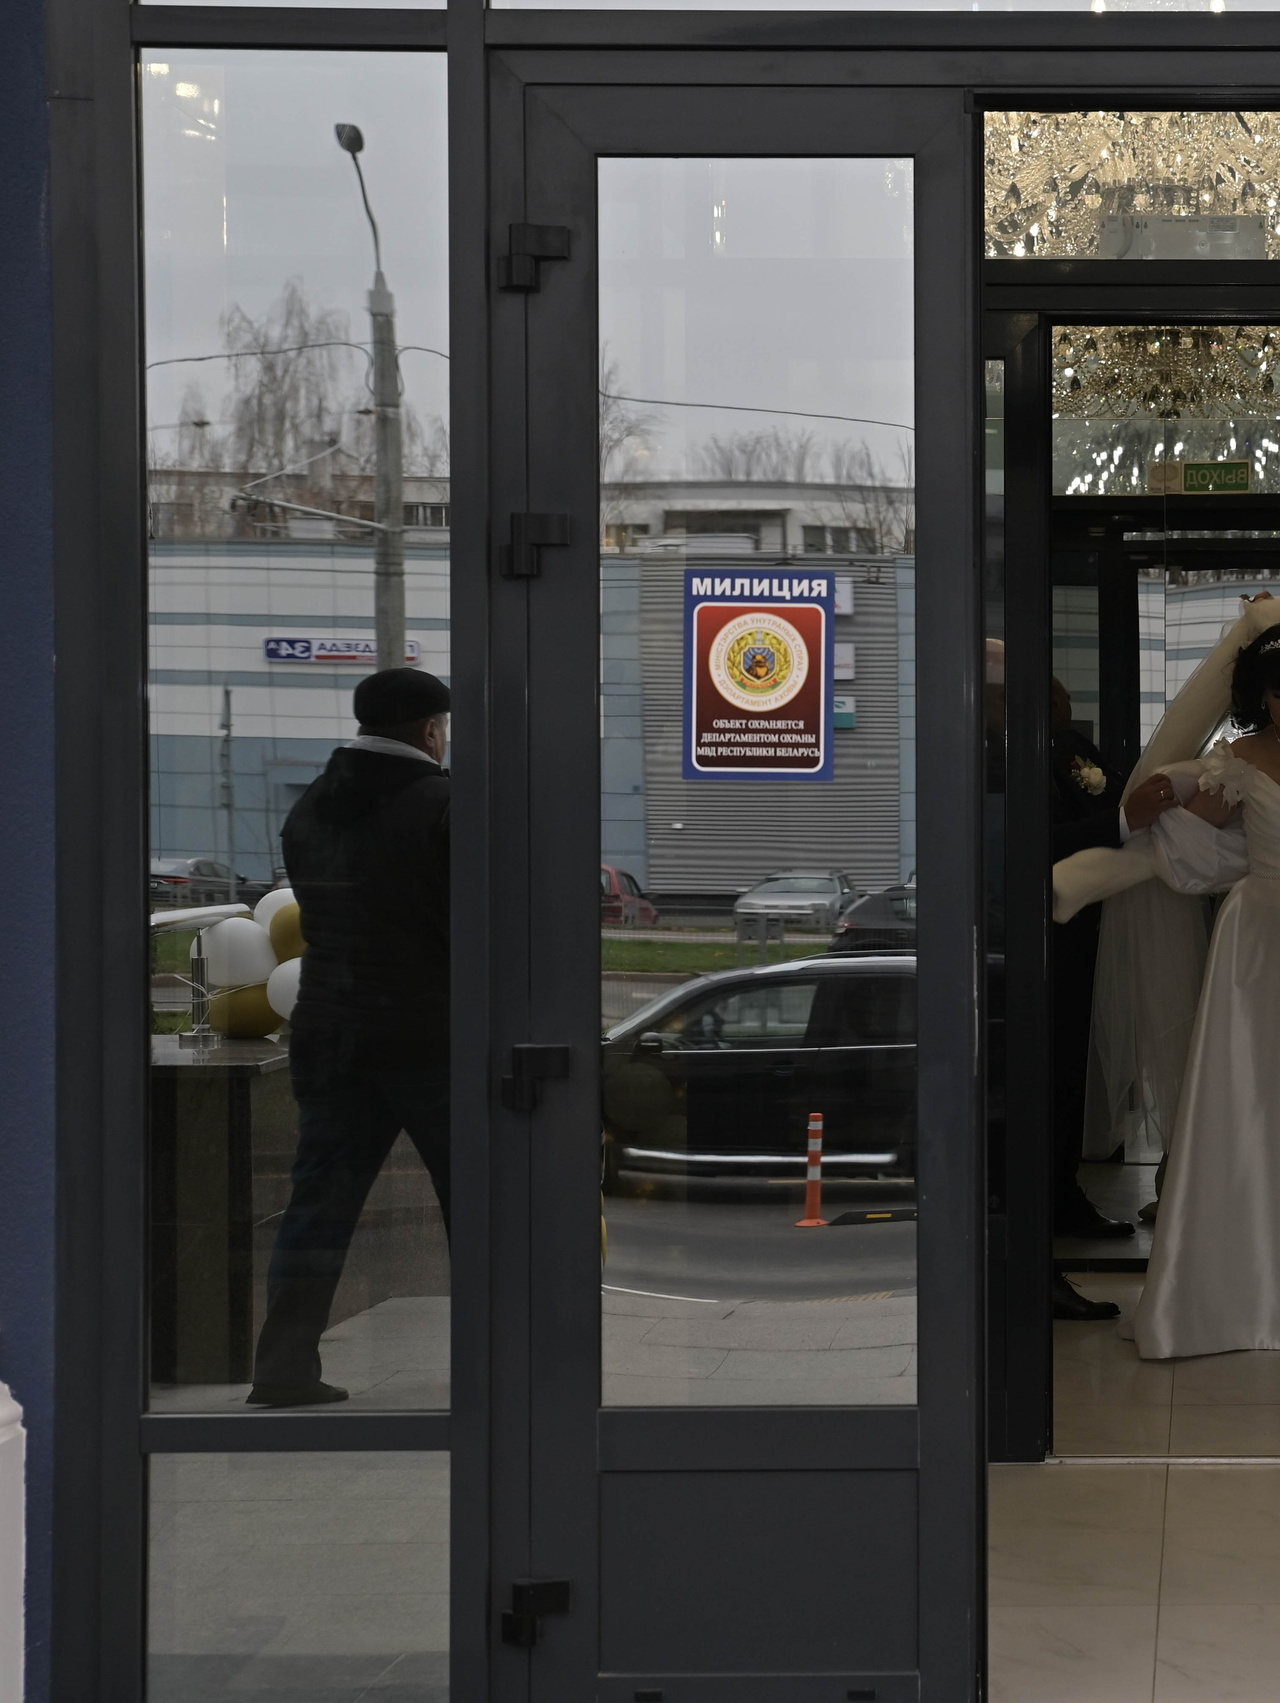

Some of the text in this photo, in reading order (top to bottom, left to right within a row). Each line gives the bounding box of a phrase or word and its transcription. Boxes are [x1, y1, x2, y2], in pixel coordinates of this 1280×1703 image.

[692, 577, 828, 600] МИЛИЦИЯ
[715, 620, 749, 670] МІНІСТЭРСТВА
[719, 678, 772, 707] ДЭПАРТАМЕНТ
[774, 680, 799, 704] АХОВЫ
[713, 719, 804, 730] ОБЪЕКТ ОХРАНЯЕТСЯ
[701, 732, 816, 744] ДЕПАРТАМЕНТОМ ОХРАНЫ
[697, 746, 820, 757] МВД РЕСПУБЛИКИ БЕЛАРУСЬ
